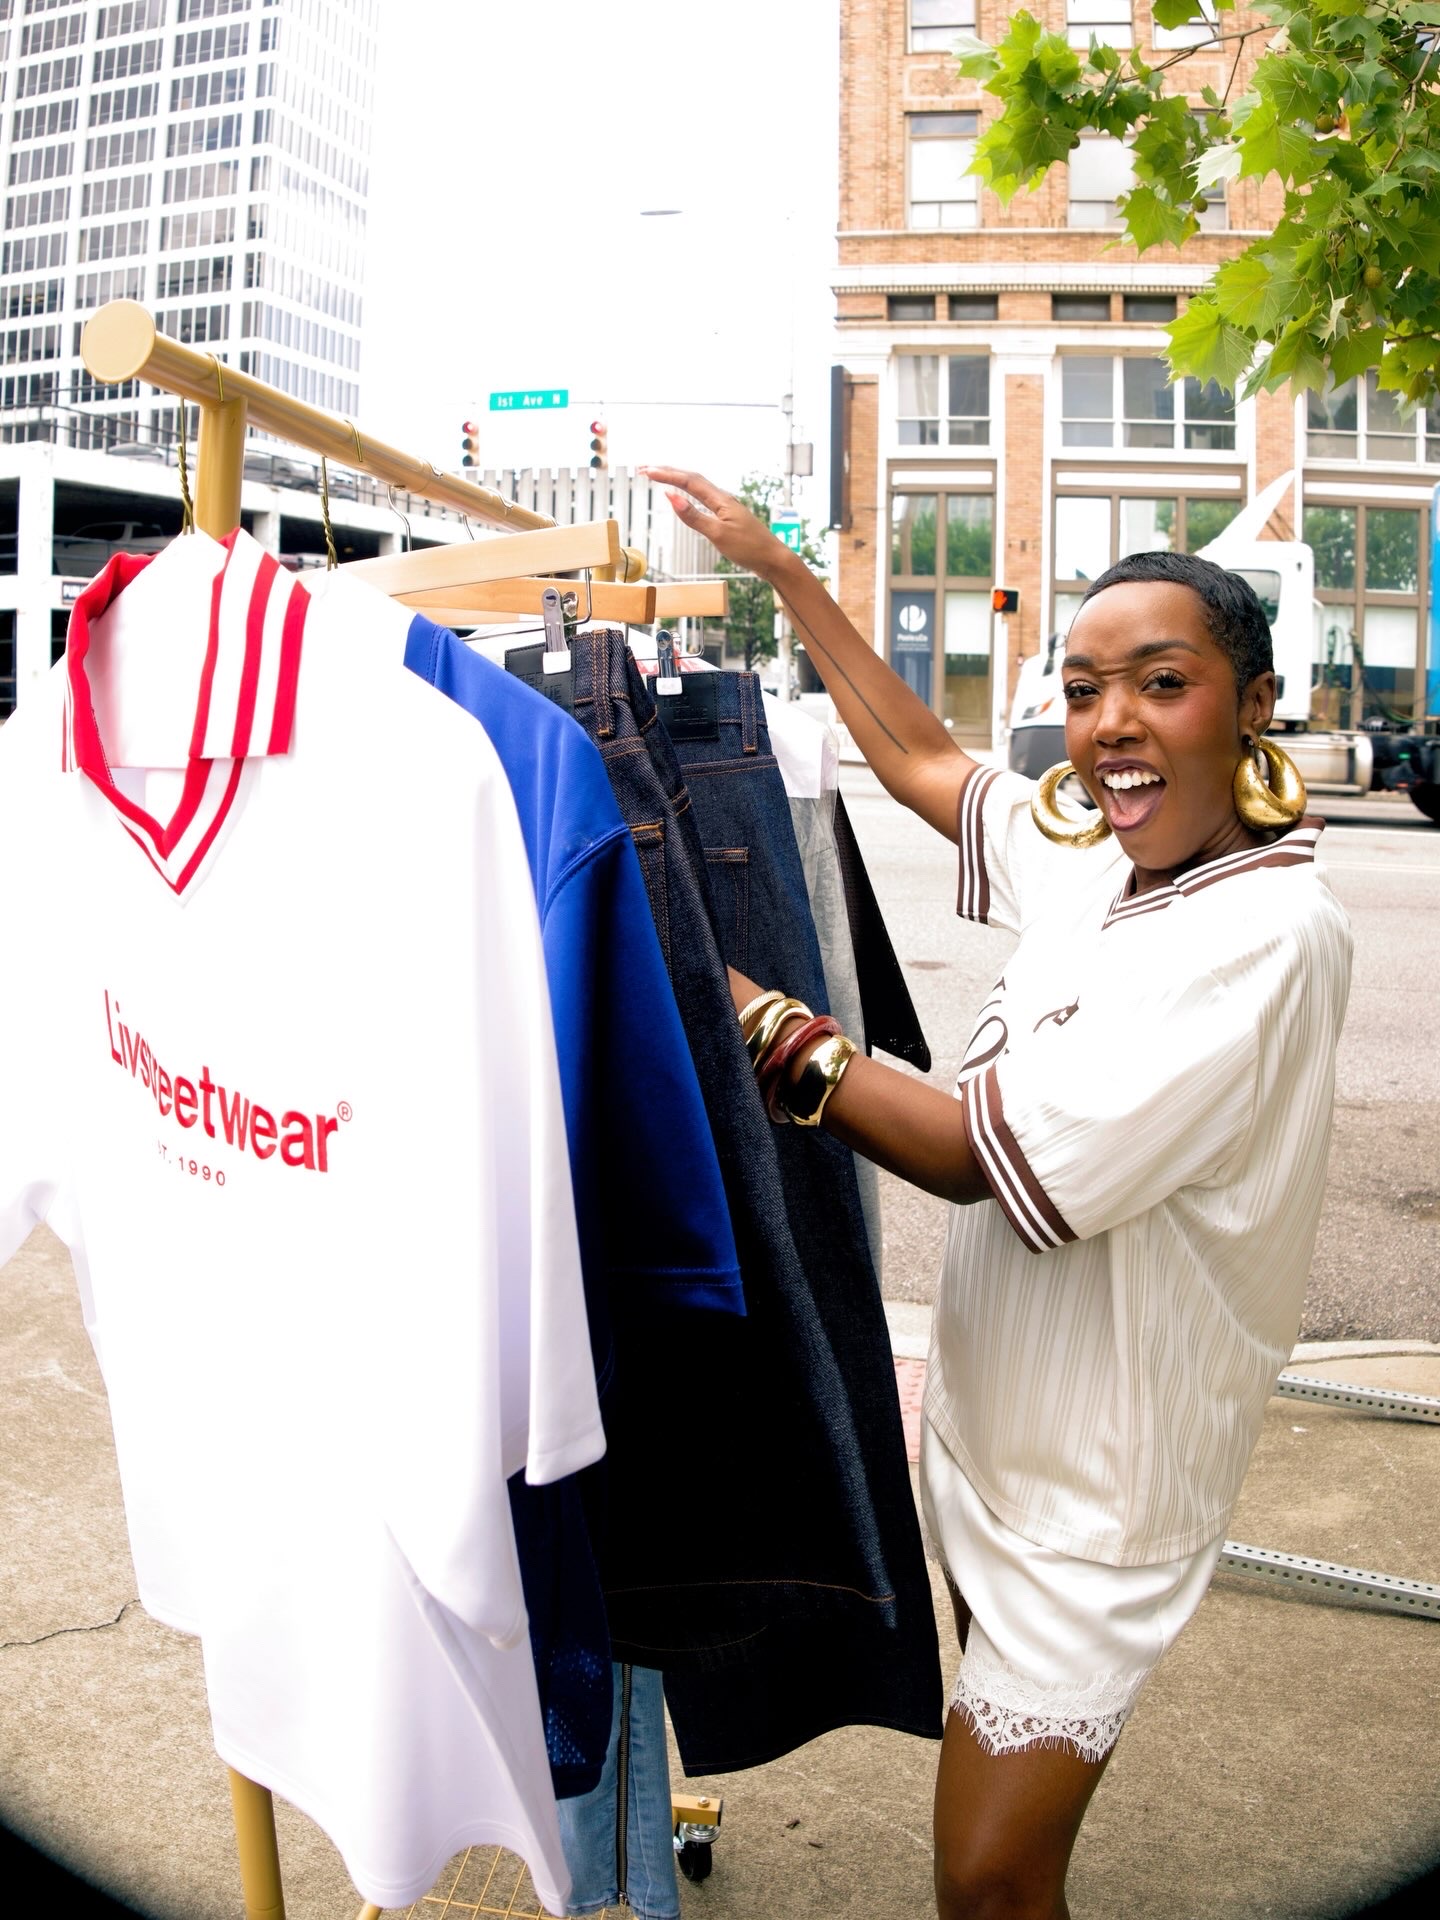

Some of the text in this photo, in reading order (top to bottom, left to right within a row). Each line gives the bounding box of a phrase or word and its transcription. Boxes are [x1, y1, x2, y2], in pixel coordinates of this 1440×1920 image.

[522, 394, 543, 407] Ave
[552, 393, 561, 405] N
[178, 1156, 226, 1187] 1990
